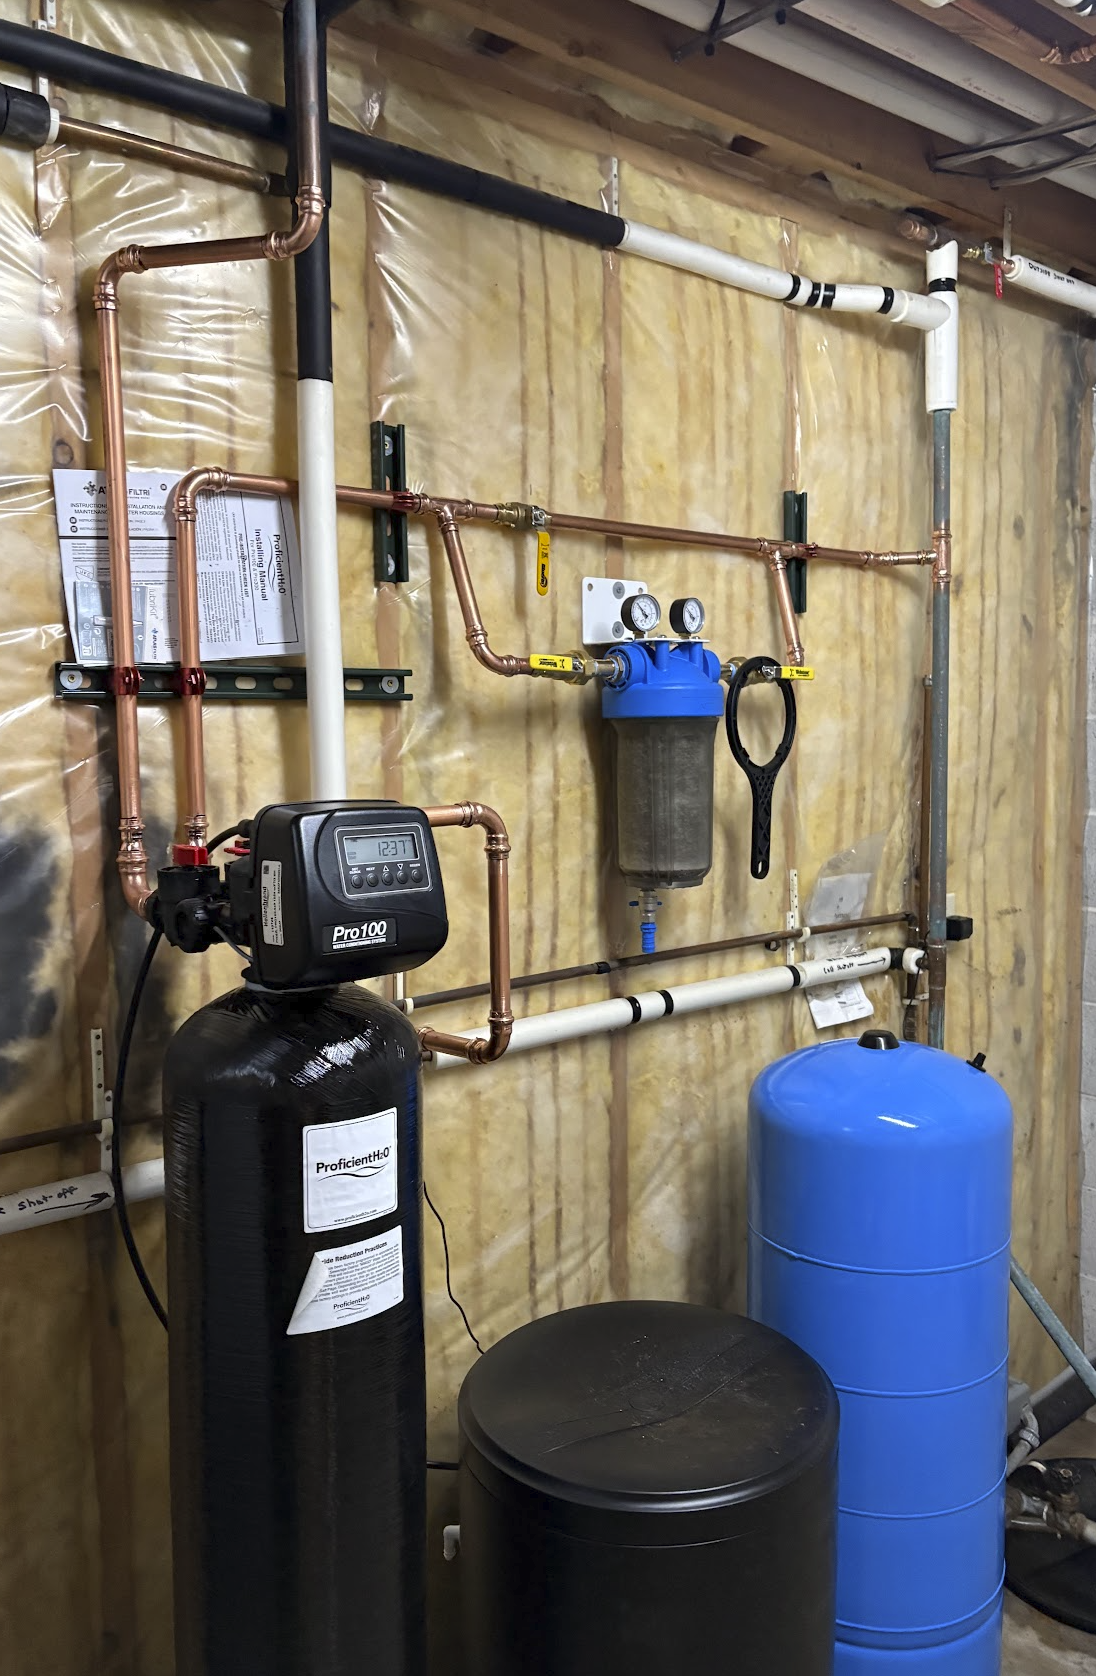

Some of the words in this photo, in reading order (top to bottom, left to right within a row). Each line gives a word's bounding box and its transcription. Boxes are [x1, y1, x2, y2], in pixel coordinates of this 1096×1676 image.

[255, 529, 264, 568] Installing
[273, 534, 286, 594] ProficientH2O
[259, 571, 268, 600] Manual
[378, 841, 406, 856] 12:37
[333, 921, 387, 941] Pro100
[316, 1146, 390, 1174] ProficientH2O
[335, 1251, 363, 1262] Reduction
[365, 1242, 387, 1253] Practices
